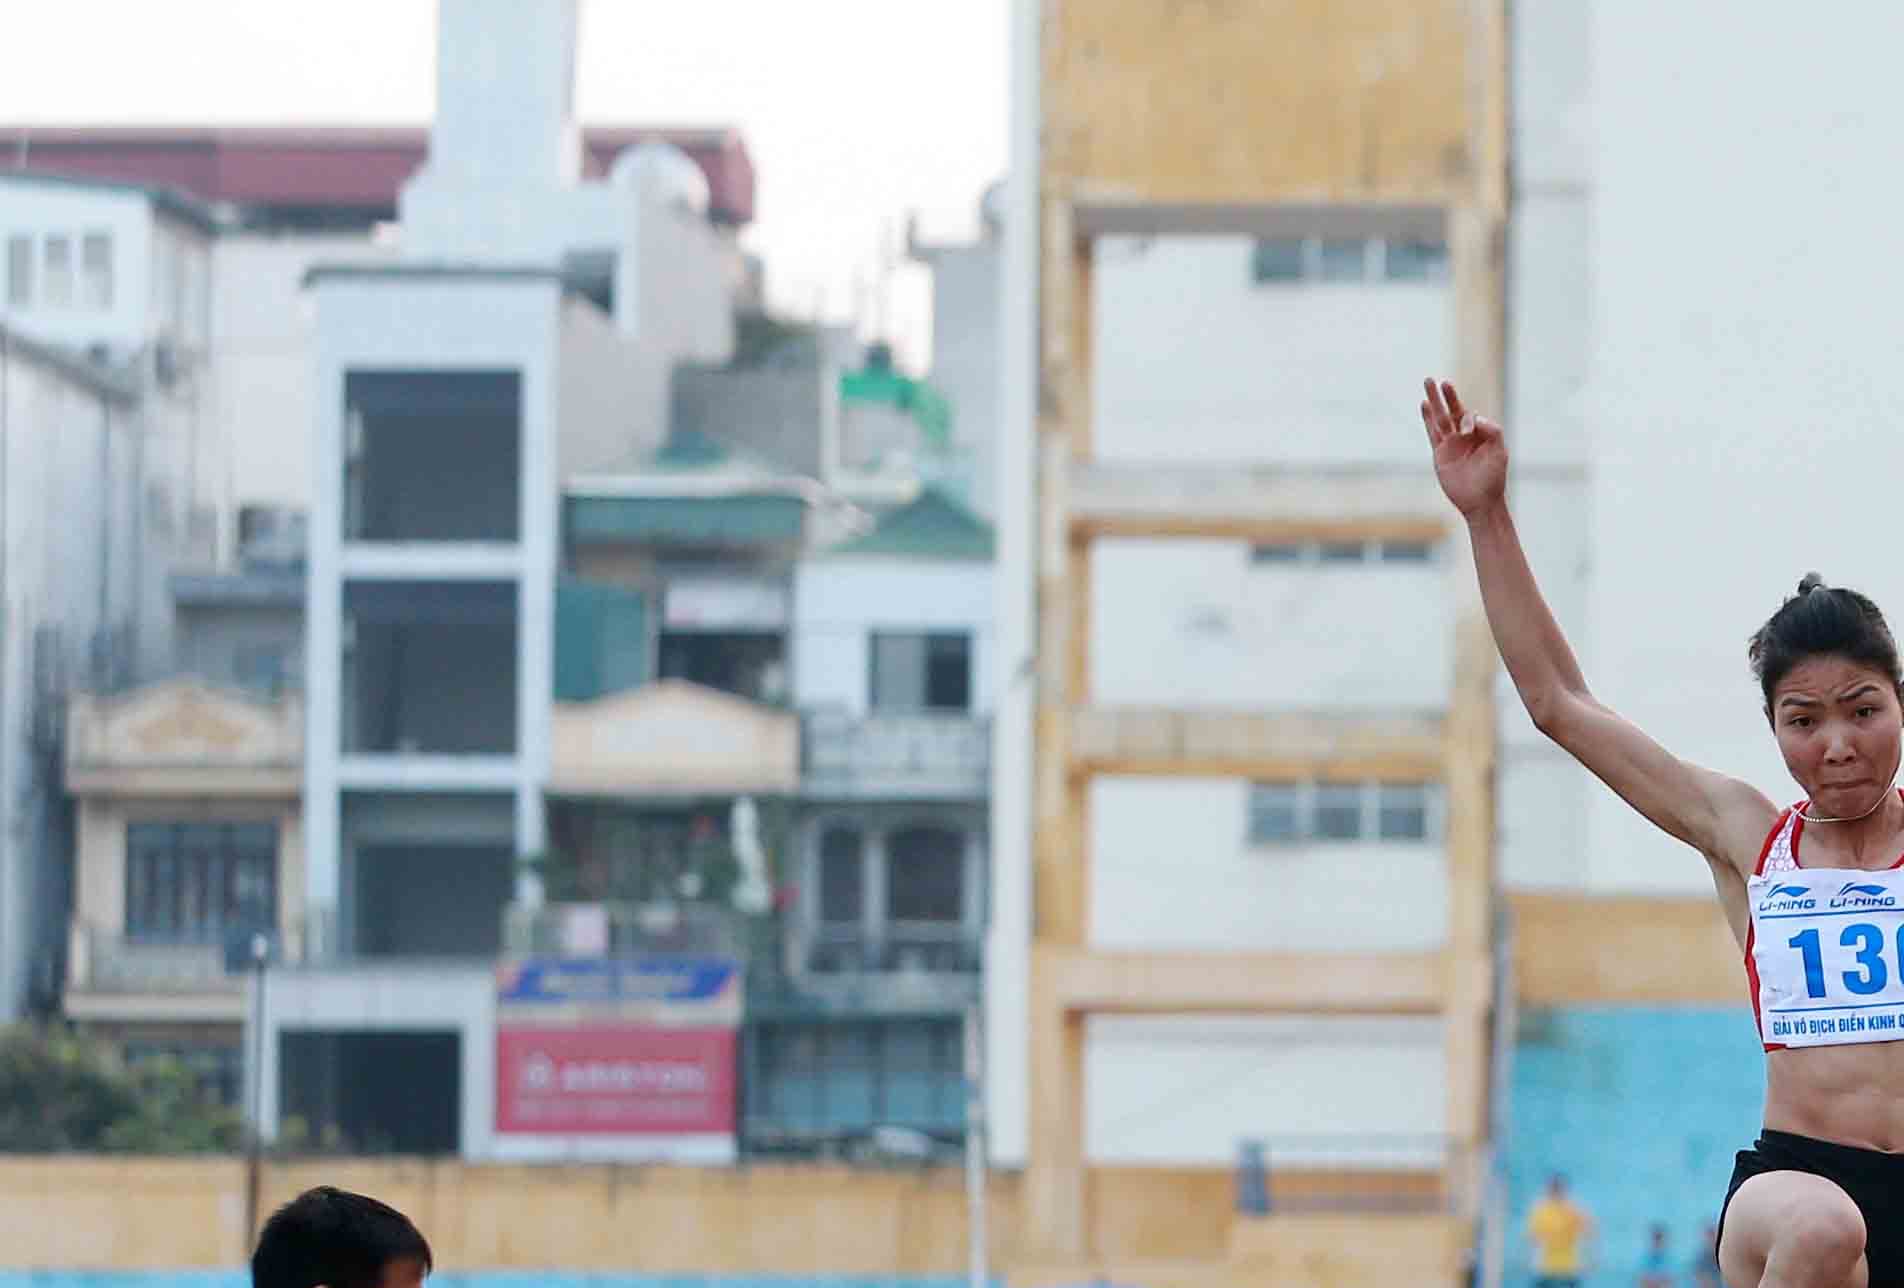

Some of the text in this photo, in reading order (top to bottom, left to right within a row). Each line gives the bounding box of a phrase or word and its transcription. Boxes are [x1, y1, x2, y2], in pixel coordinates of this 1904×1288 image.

[1759, 898, 1816, 911] LI-NING
[1829, 896, 1896, 908] LI-NING
[1809, 1018, 1836, 1037] ĐỊCH
[1868, 1015, 1896, 1030] KINH
